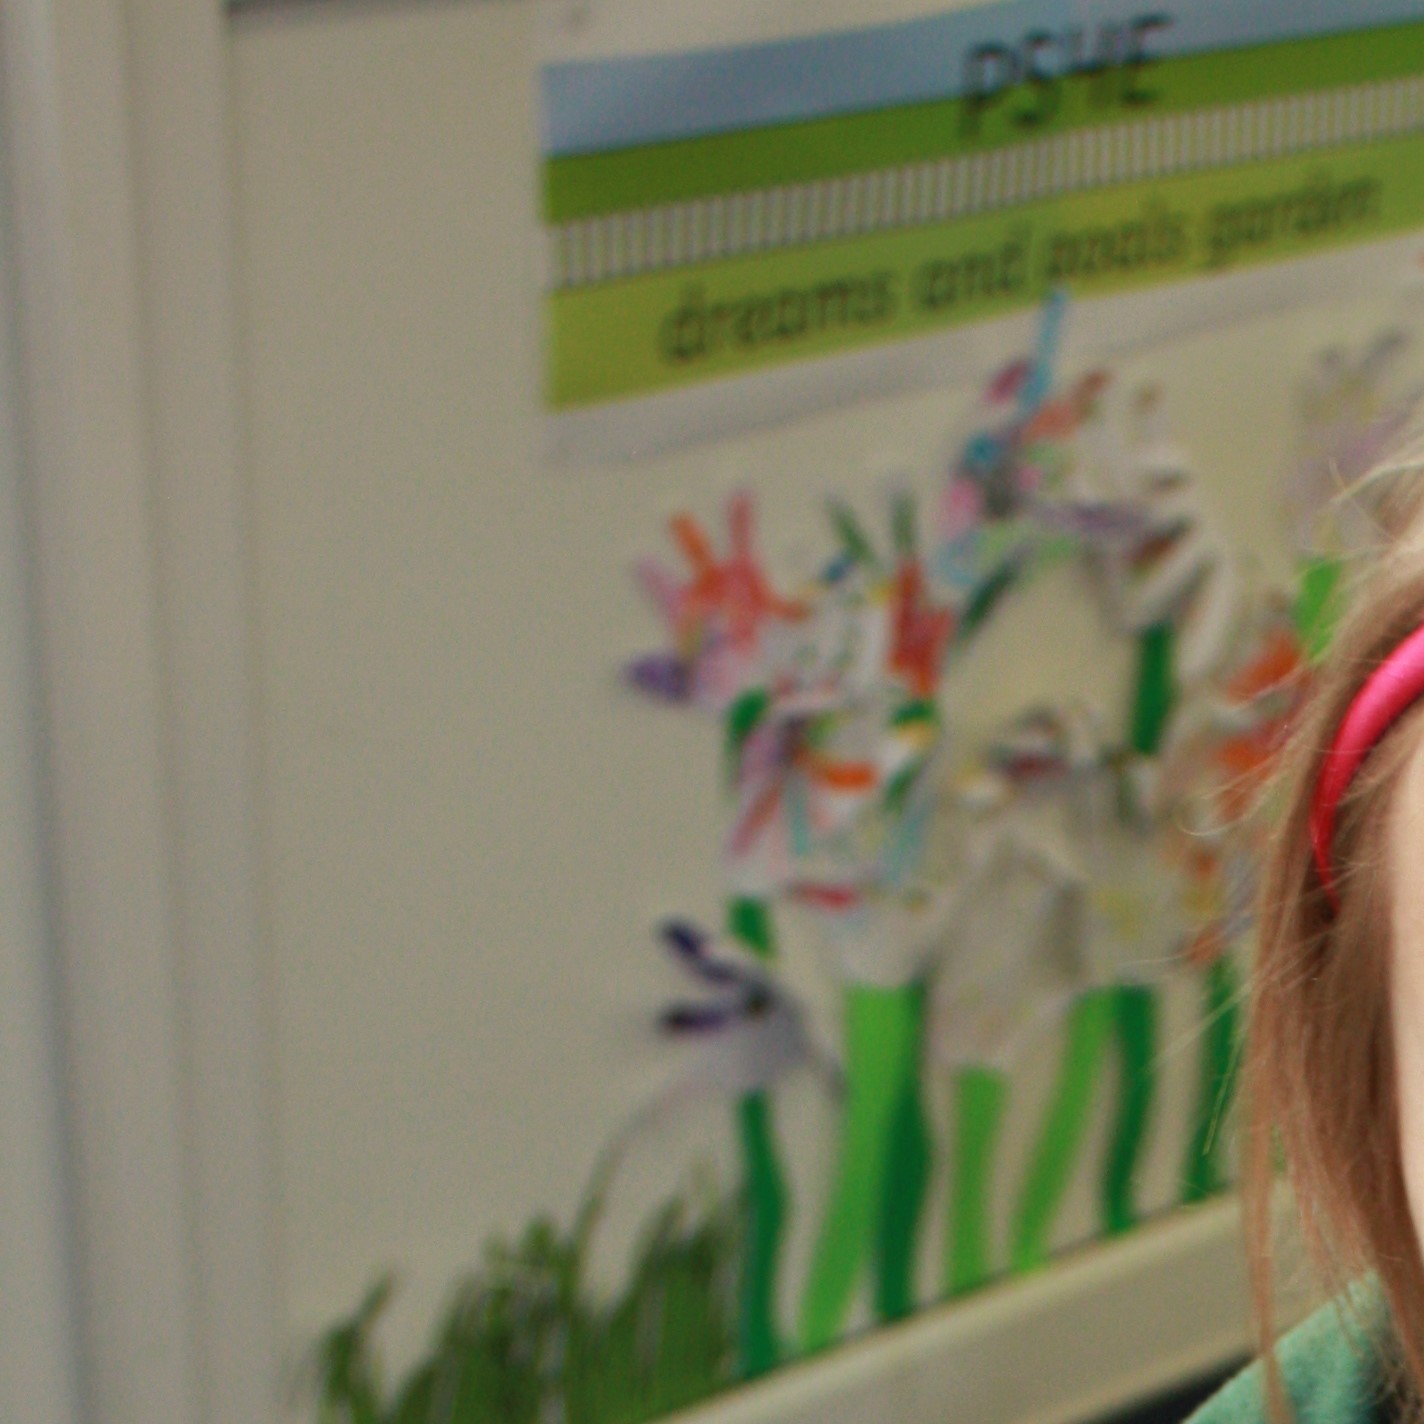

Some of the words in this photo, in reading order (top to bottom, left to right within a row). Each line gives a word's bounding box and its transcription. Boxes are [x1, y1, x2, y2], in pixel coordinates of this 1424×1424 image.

[958, 12, 1172, 138] PSHE
[661, 276, 898, 364] dreams
[914, 226, 1032, 311] and
[1206, 172, 1383, 268] garden
